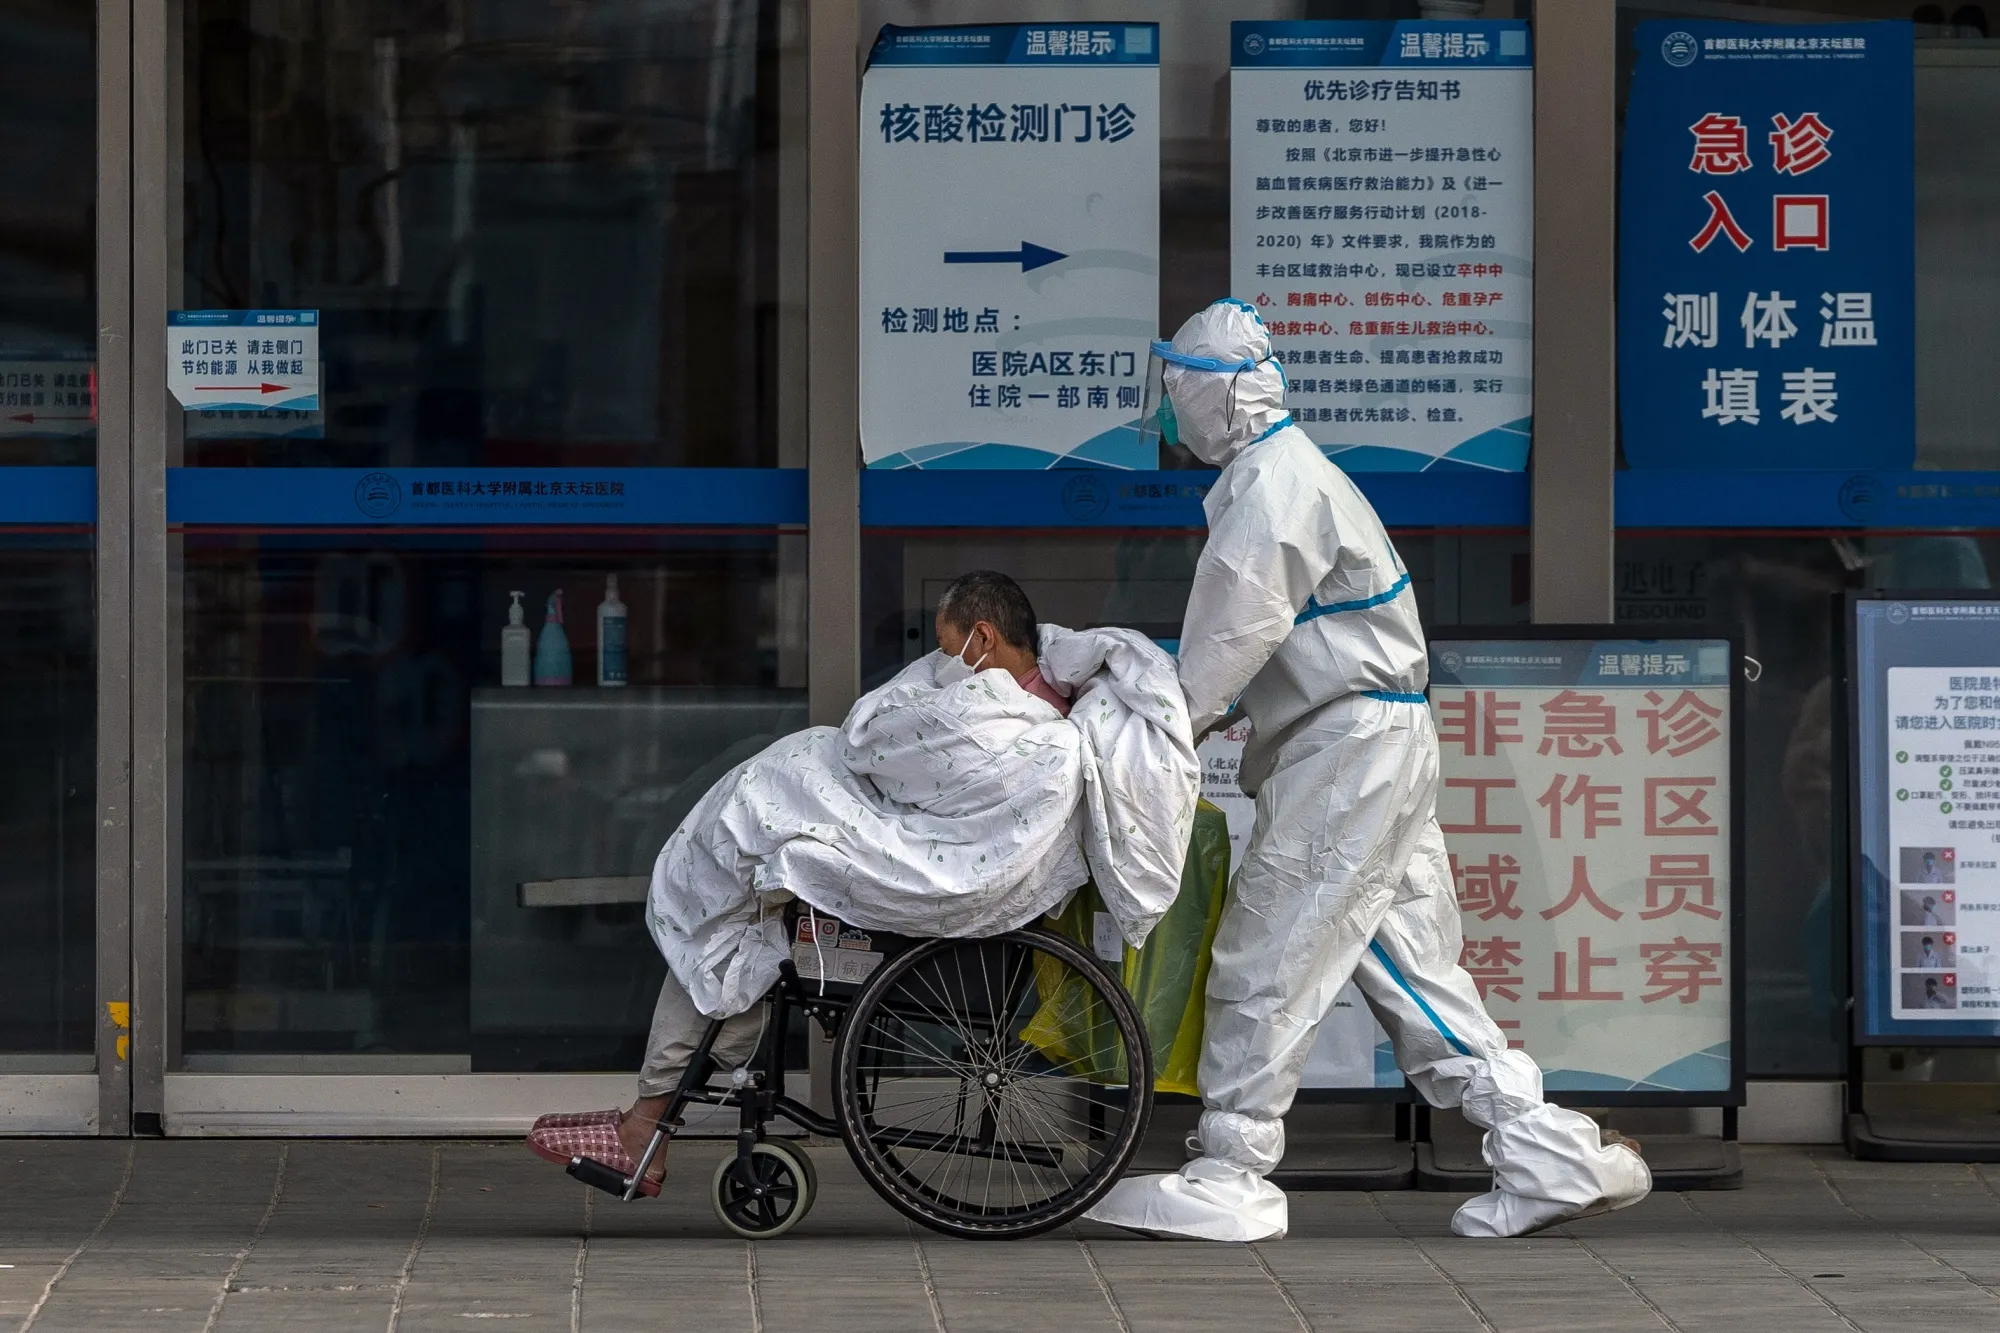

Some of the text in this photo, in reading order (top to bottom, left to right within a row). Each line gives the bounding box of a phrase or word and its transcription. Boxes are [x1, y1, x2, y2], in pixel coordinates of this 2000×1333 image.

[1026, 30, 1112, 55] 温馨提示
[1400, 32, 1487, 58] 温馨提示
[1703, 37, 1866, 50] 首都医科大学附属北京天坛医院
[1304, 80, 1461, 101] 优先诊疗告知书
[880, 102, 1136, 143] 核酸检测门诊
[1688, 112, 1834, 176] 急诊
[1688, 190, 1830, 253] 入口
[1662, 290, 1878, 348] 测体温
[181, 339, 303, 355] 此门已关 请走侧门
[181, 359, 304, 375] 节约能源 从我做起
[972, 350, 1136, 377] 医院A区东门
[968, 384, 1140, 409] 住院一部南侧
[1702, 367, 1839, 426] 填表
[411, 481, 625, 496] 首都医科大学附属北京天坛医院
[1599, 654, 1686, 676] 温馨提示
[1439, 689, 1723, 758] 非急诊
[1440, 773, 1719, 839] 工作区
[1448, 853, 1722, 922] 域人员
[1458, 935, 1722, 1004] 禁止穿
